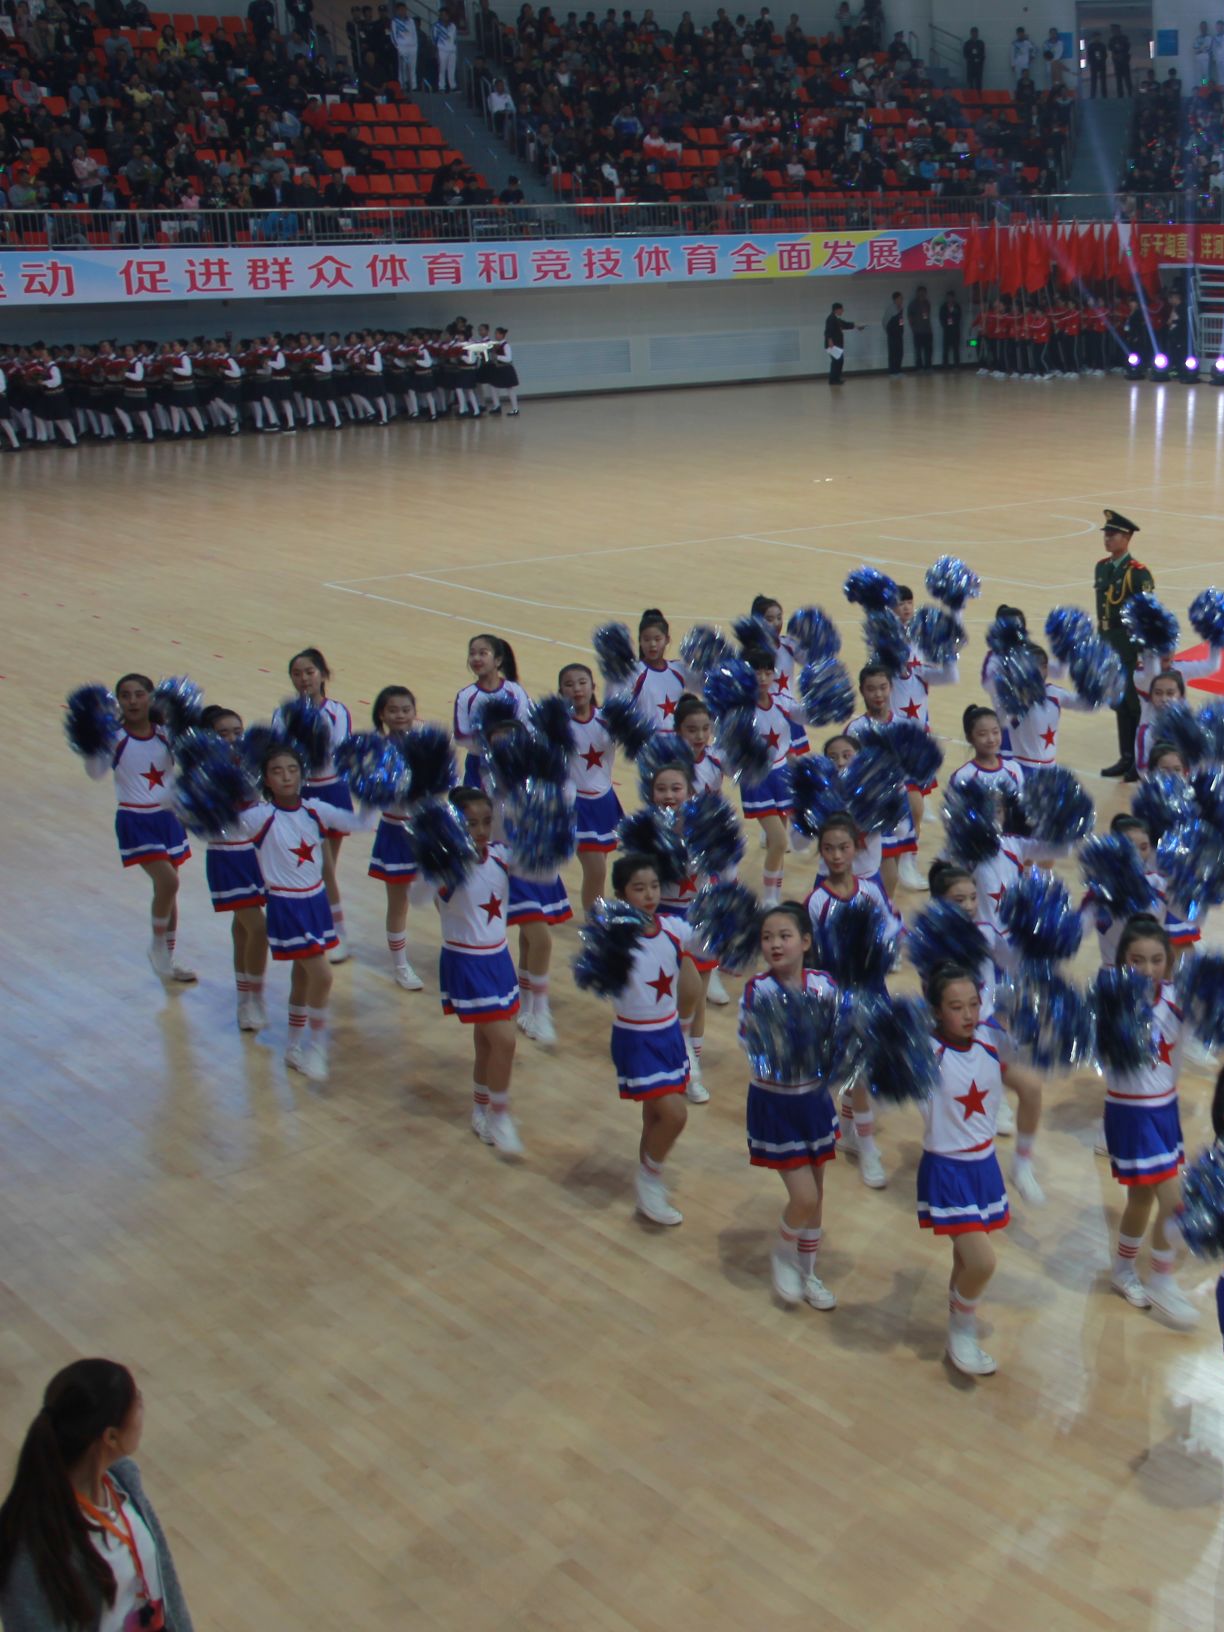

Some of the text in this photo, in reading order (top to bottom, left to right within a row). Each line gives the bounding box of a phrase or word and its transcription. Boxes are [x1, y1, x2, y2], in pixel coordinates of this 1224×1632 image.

[0, 238, 903, 298] 动 促进群众体育和竞技体育全面发展
